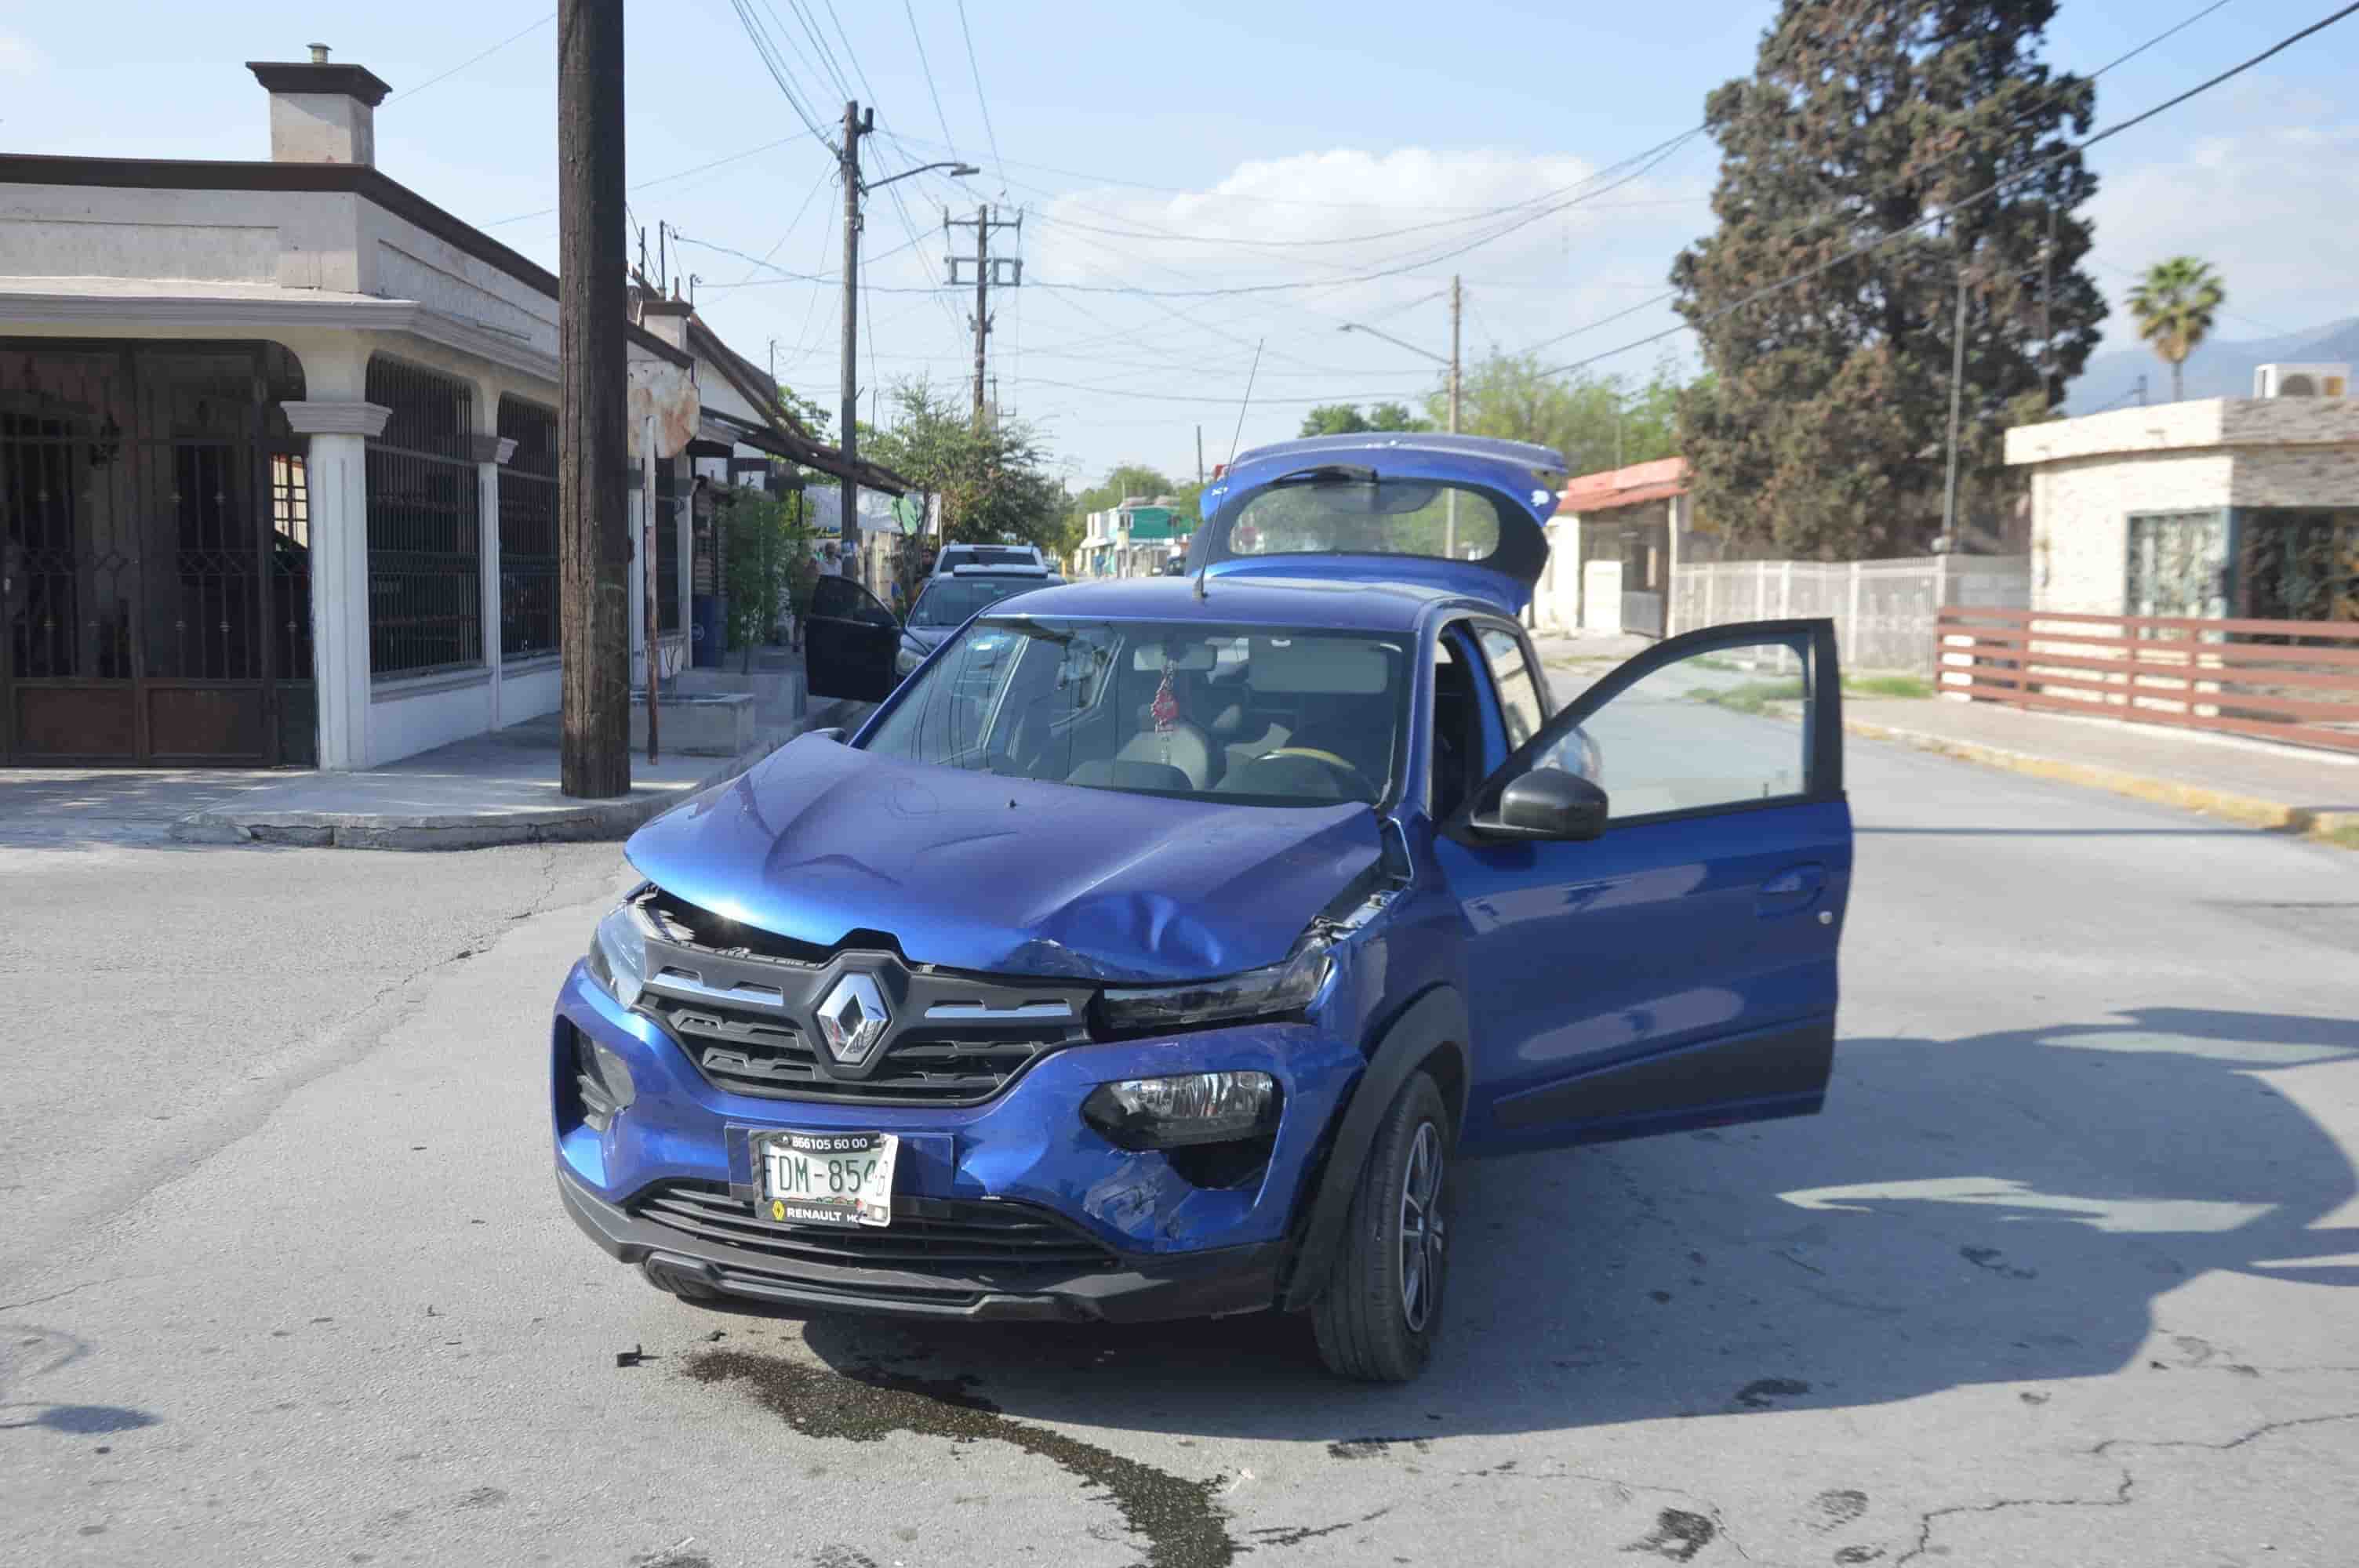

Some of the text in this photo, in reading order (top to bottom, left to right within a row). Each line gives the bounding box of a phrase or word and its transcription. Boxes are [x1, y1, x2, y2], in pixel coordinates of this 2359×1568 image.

[834, 1138, 849, 1149] 60
[852, 1138, 868, 1149] 00
[787, 1207, 842, 1222] RENAULT
